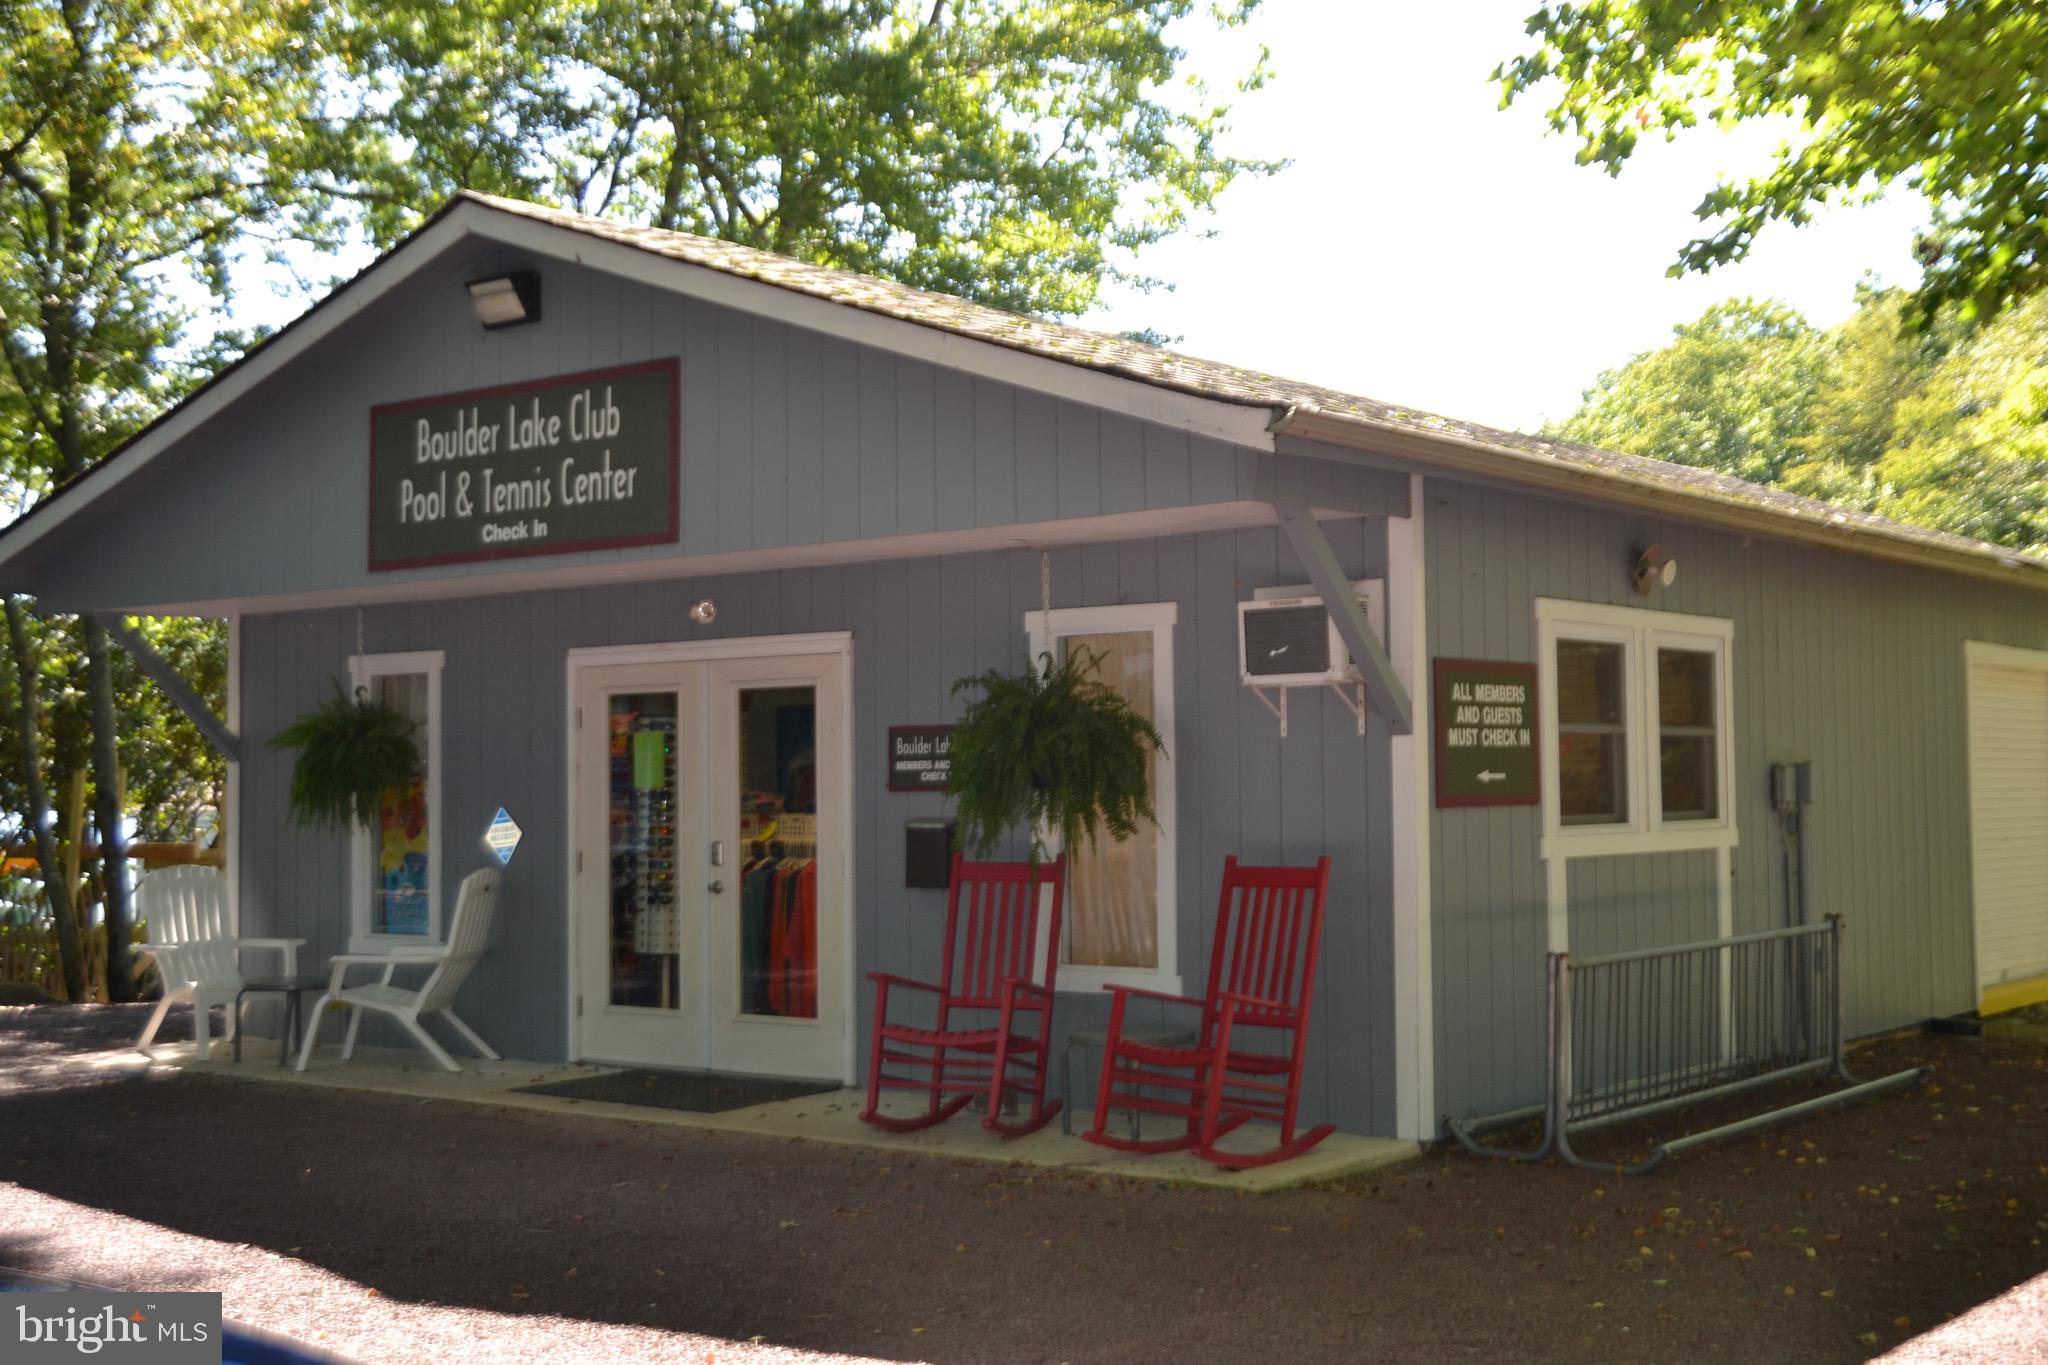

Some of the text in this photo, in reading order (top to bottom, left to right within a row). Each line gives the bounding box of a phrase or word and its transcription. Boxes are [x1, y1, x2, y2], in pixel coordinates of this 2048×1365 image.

[417, 385, 620, 463] Boulder Lake Club
[400, 450, 637, 523] Pool & Tennis Center
[482, 518, 547, 544] Check In
[1453, 682, 1526, 703] ALL MEMBERS
[1456, 705, 1523, 724] AND GUESTS
[897, 736, 933, 754] Boulder
[1448, 728, 1530, 747] MUST CHECK IN
[895, 760, 933, 770] MEMBERS
[921, 771, 948, 781] CHECK
